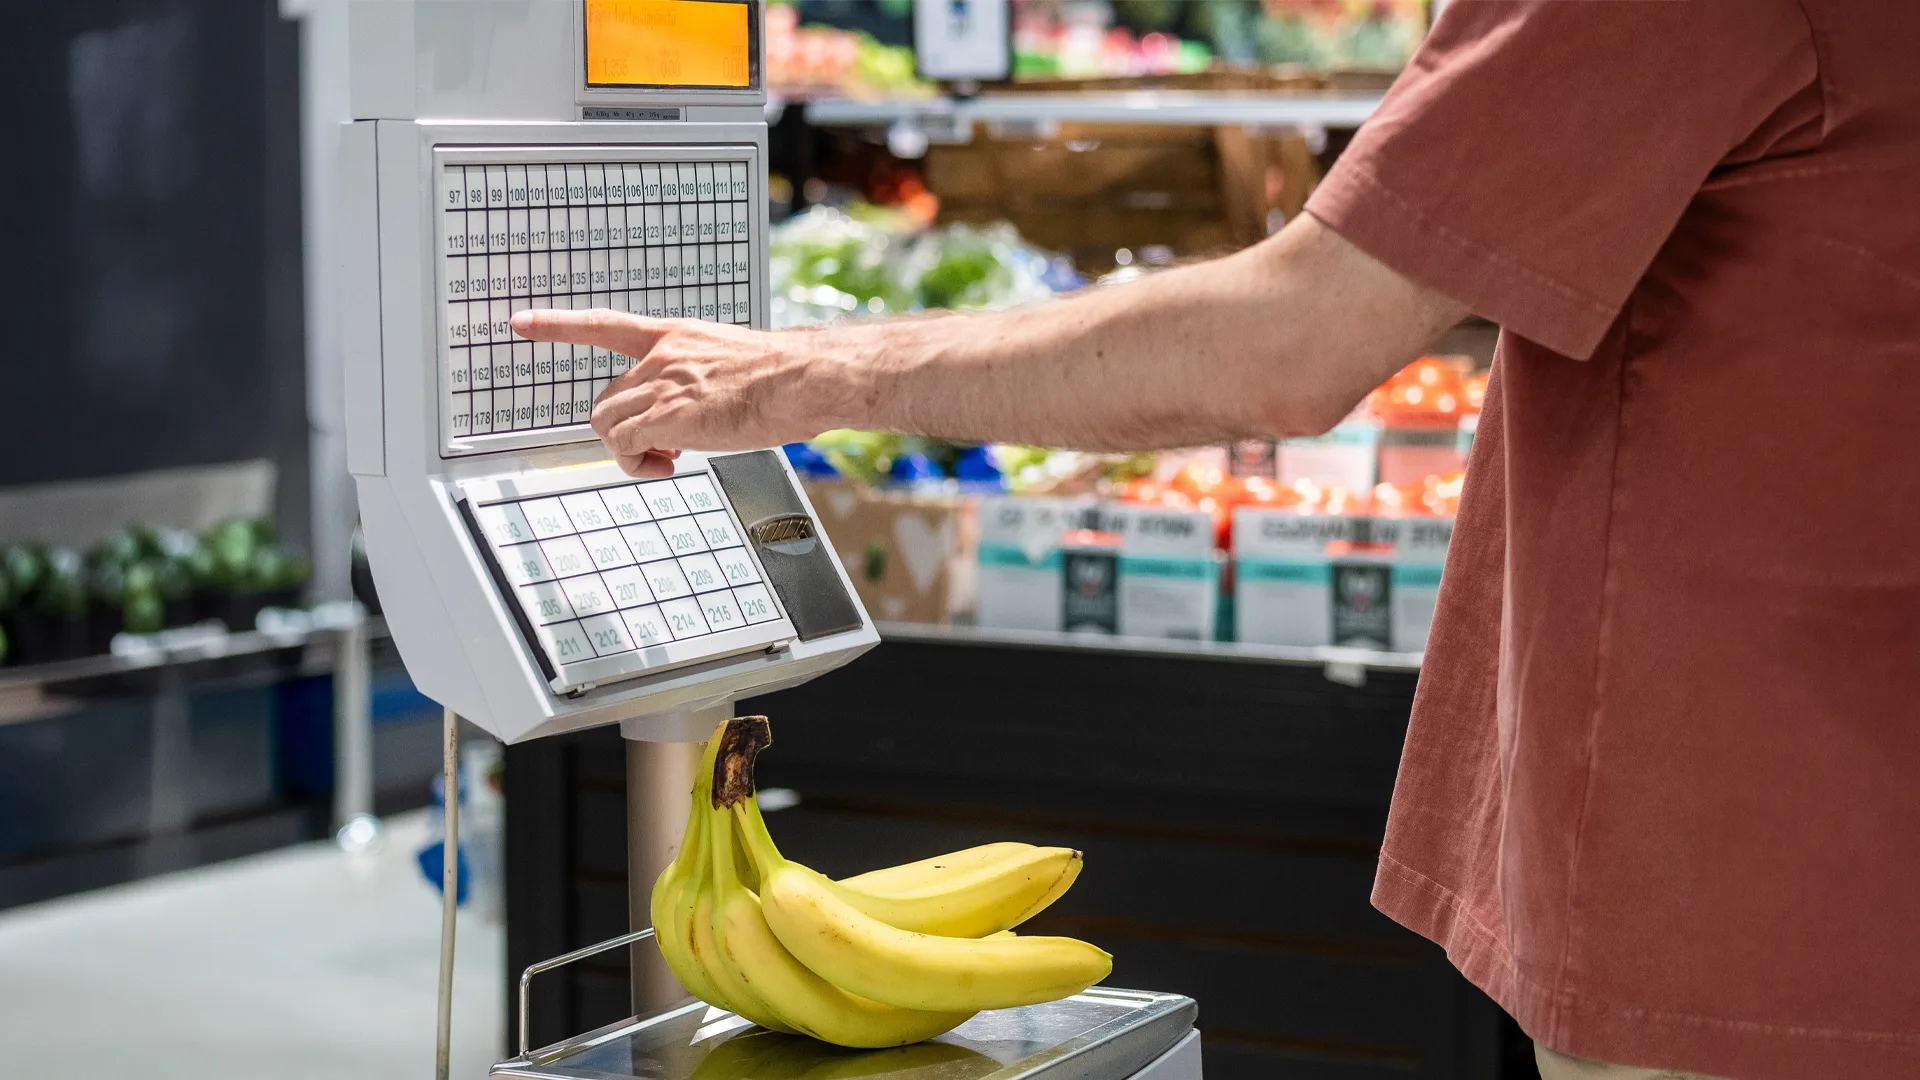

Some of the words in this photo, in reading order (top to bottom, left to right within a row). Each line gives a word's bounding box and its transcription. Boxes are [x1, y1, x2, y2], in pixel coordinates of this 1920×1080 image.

[449, 190, 460, 203] 97
[471, 190, 482, 202] 98
[492, 189, 502, 202] 99
[510, 188, 525, 201] 100
[530, 188, 544, 200] 101
[550, 187, 564, 200] 102
[569, 187, 584, 199] 103
[588, 186, 602, 198] 104
[608, 186, 622, 197] 105
[627, 185, 641, 197] 106
[645, 185, 658, 196] 107
[663, 184, 676, 195] 108
[681, 183, 694, 195] 109
[699, 183, 711, 194] 110
[716, 182, 728, 193] 111
[733, 182, 745, 193] 112
[448, 235, 464, 248] 113
[470, 235, 485, 247] 114
[491, 234, 505, 246] 115
[511, 233, 526, 245] 116
[531, 232, 545, 244] 117
[551, 231, 565, 243] 118
[571, 230, 584, 242] 119
[590, 229, 604, 241] 120
[609, 228, 622, 240] 121
[628, 227, 642, 239] 122
[647, 226, 659, 238] 123
[664, 225, 677, 237] 124
[682, 224, 694, 236] 125
[700, 223, 712, 235] 126
[717, 222, 729, 234] 127
[734, 222, 746, 233] 128
[449, 280, 466, 293] 129
[471, 279, 486, 292] 130
[492, 278, 506, 290] 131
[512, 276, 527, 289] 132
[532, 275, 547, 287] 133
[552, 274, 567, 286] 134
[572, 272, 586, 285] 135
[591, 271, 604, 283] 136
[610, 270, 623, 282] 137
[629, 269, 642, 281] 138
[647, 268, 660, 279] 139
[665, 266, 678, 278] 140
[683, 265, 695, 277] 141
[701, 264, 713, 276] 142
[718, 263, 731, 274] 143
[735, 262, 746, 273] 144
[666, 308, 679, 318] 156
[683, 306, 696, 317] 157
[702, 305, 714, 316] 158
[718, 303, 731, 315] 159
[736, 302, 747, 313] 160
[450, 325, 467, 338] 145
[472, 323, 488, 336] 146
[493, 322, 508, 335] 147
[452, 370, 467, 383] 161
[473, 368, 489, 380] 162
[495, 366, 510, 379] 163
[515, 364, 531, 376] 164
[536, 362, 551, 374] 165
[556, 360, 570, 372] 166
[575, 358, 588, 370] 167
[594, 356, 607, 368] 168
[612, 354, 625, 366] 169
[453, 414, 469, 427] 177
[475, 412, 490, 425] 178
[496, 410, 511, 423] 179
[516, 407, 531, 420] 180
[535, 405, 550, 418] 181
[555, 403, 570, 416] 182
[575, 401, 589, 413] 183
[497, 522, 521, 540] 193
[537, 516, 560, 533] 194
[577, 510, 601, 526] 195
[616, 504, 638, 520] 196
[654, 497, 676, 514] 197
[690, 492, 712, 508] 198
[517, 560, 540, 578] 199
[556, 555, 580, 572] 200
[596, 546, 622, 564] 201
[634, 540, 656, 556] 202
[672, 532, 696, 550] 203
[708, 527, 730, 544] 204
[536, 599, 560, 618] 205
[574, 592, 601, 610] 206
[616, 583, 637, 600] 207
[654, 577, 676, 594] 208
[692, 569, 714, 586] 209
[727, 562, 748, 580] 210
[556, 638, 580, 656] 211
[595, 630, 621, 648] 212
[636, 622, 658, 639] 213
[672, 614, 696, 632] 214
[708, 606, 731, 624] 215
[744, 598, 766, 616] 216
